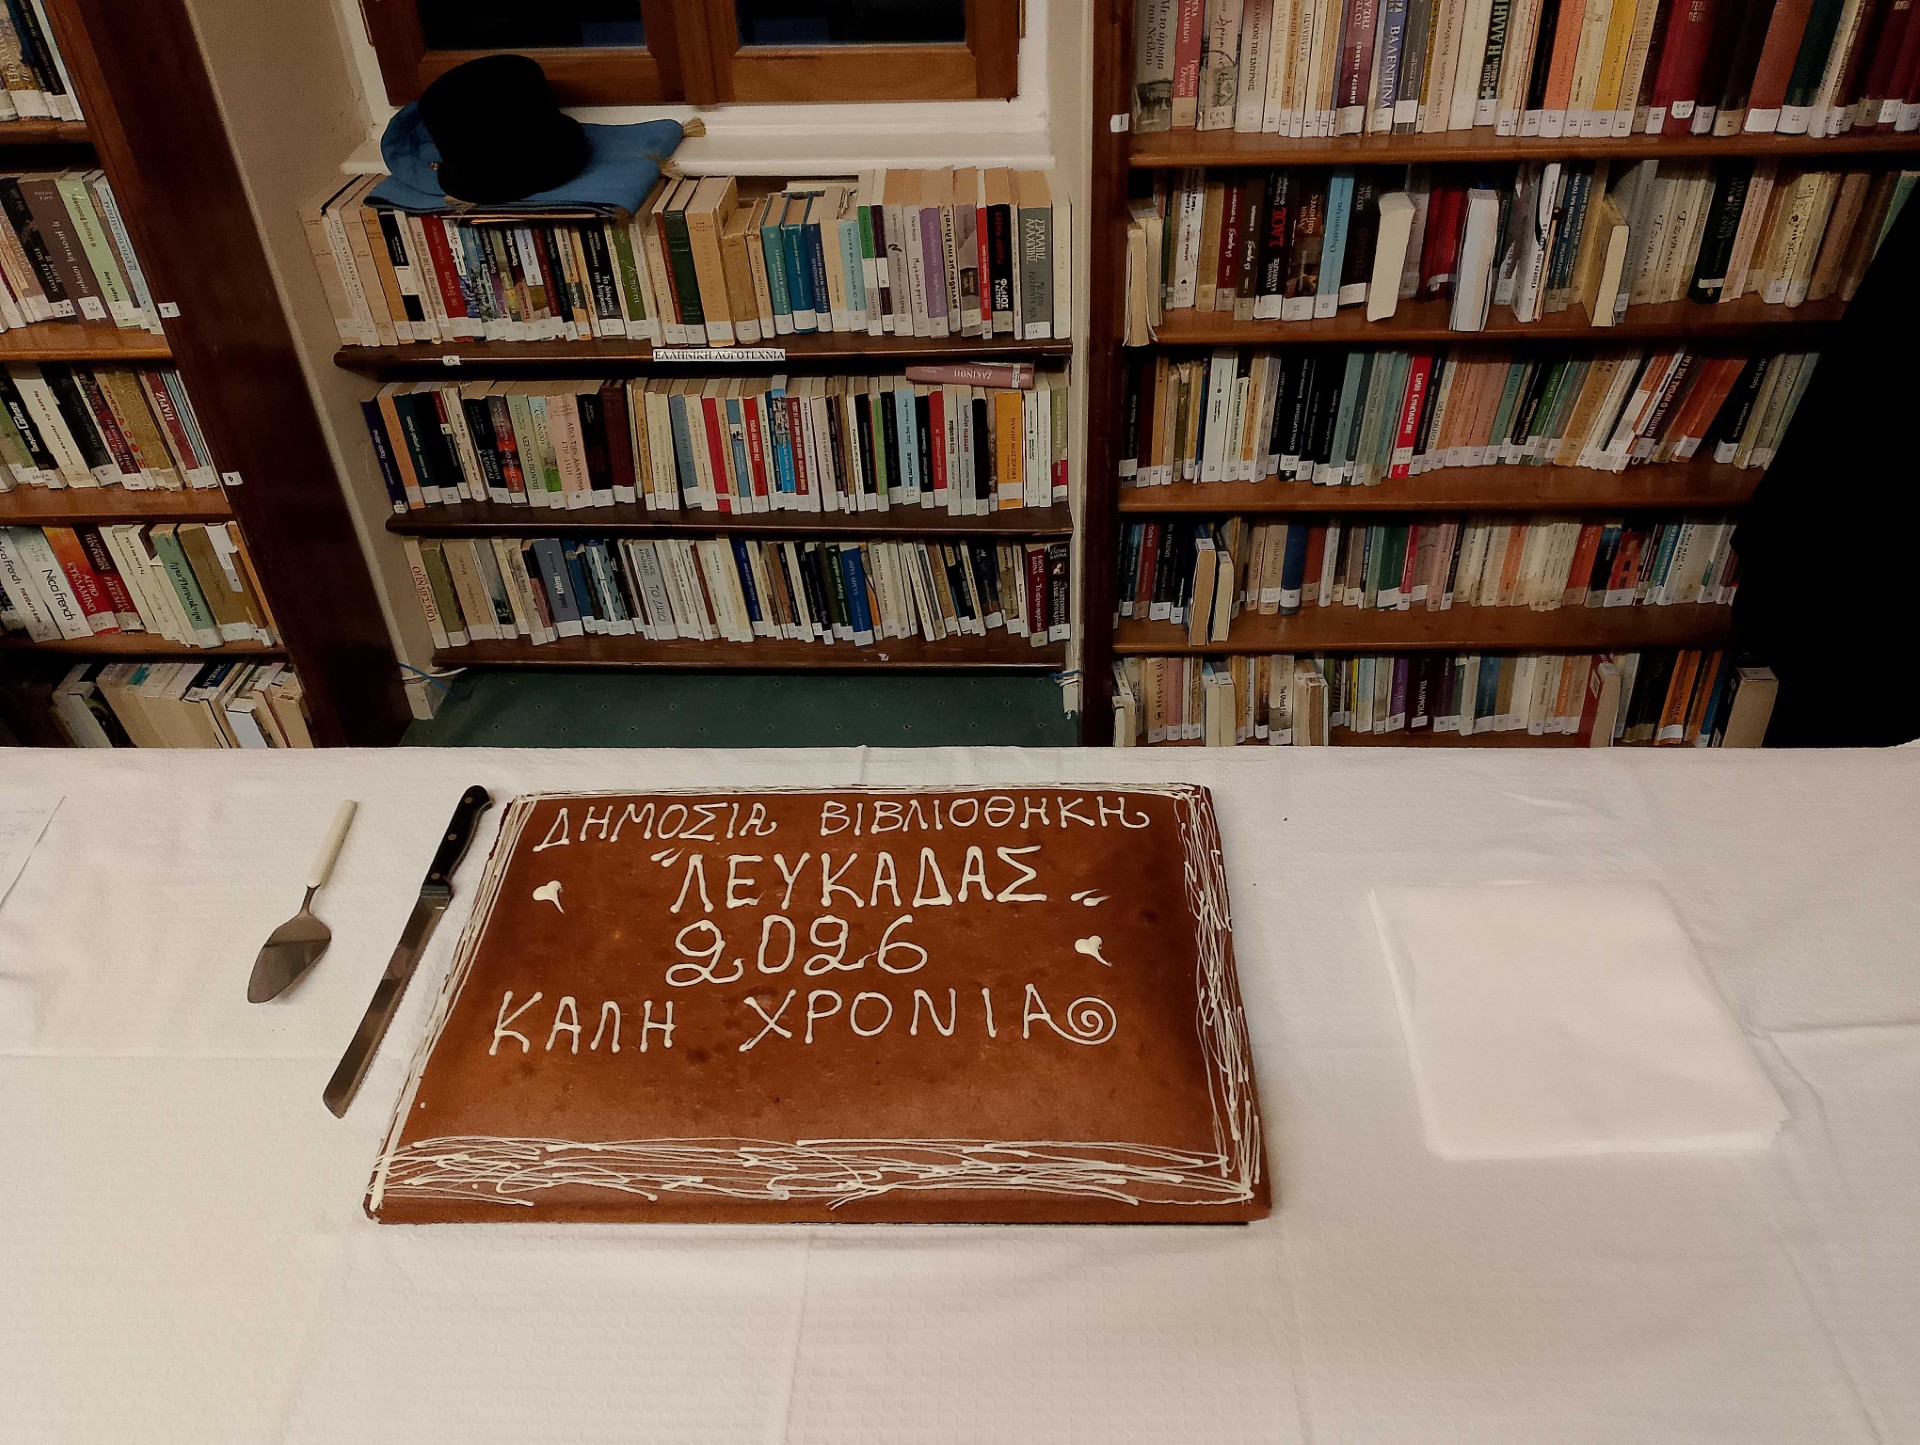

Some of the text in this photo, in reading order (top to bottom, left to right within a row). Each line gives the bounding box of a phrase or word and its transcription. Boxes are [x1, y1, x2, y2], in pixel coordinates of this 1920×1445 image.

[1145, 27, 1156, 66] Νείλου
[1157, 31, 1167, 70] άρωμα
[1380, 25, 1400, 109] ΒΑΛΕΝΤΙΝΑ
[1269, 207, 1288, 248] ΣΑΟΣ
[1306, 194, 1320, 235] δαίμονες
[947, 243, 955, 260] την
[1000, 278, 1009, 309] ΦΟΝΟΣ
[655, 350, 785, 360] ΕΛΛΗΝΙΚΗ ΛΟΓΟΤΕΧΝΙΑ
[522, 436, 534, 463] ΑΞΕΝΟΣ
[567, 422, 585, 491] ΑΠΟ ΤΗΝ ΑΝΑΤΟΛΗ
[528, 463, 540, 490] ΠΟΝΤΟΣ
[66, 562, 97, 612] ΚΥΚΛΑΜΙΝΟ
[83, 574, 99, 597] ΑΓΡΙΟ
[533, 795, 1150, 851] ΔΗΜΟΣΙΑ ΒΙΒΛΙΟΘΗΚΗ
[665, 913, 928, 987] 2026
[488, 983, 1062, 1056] ΚΑΛΗ ΧΡΟΝΙΑ
